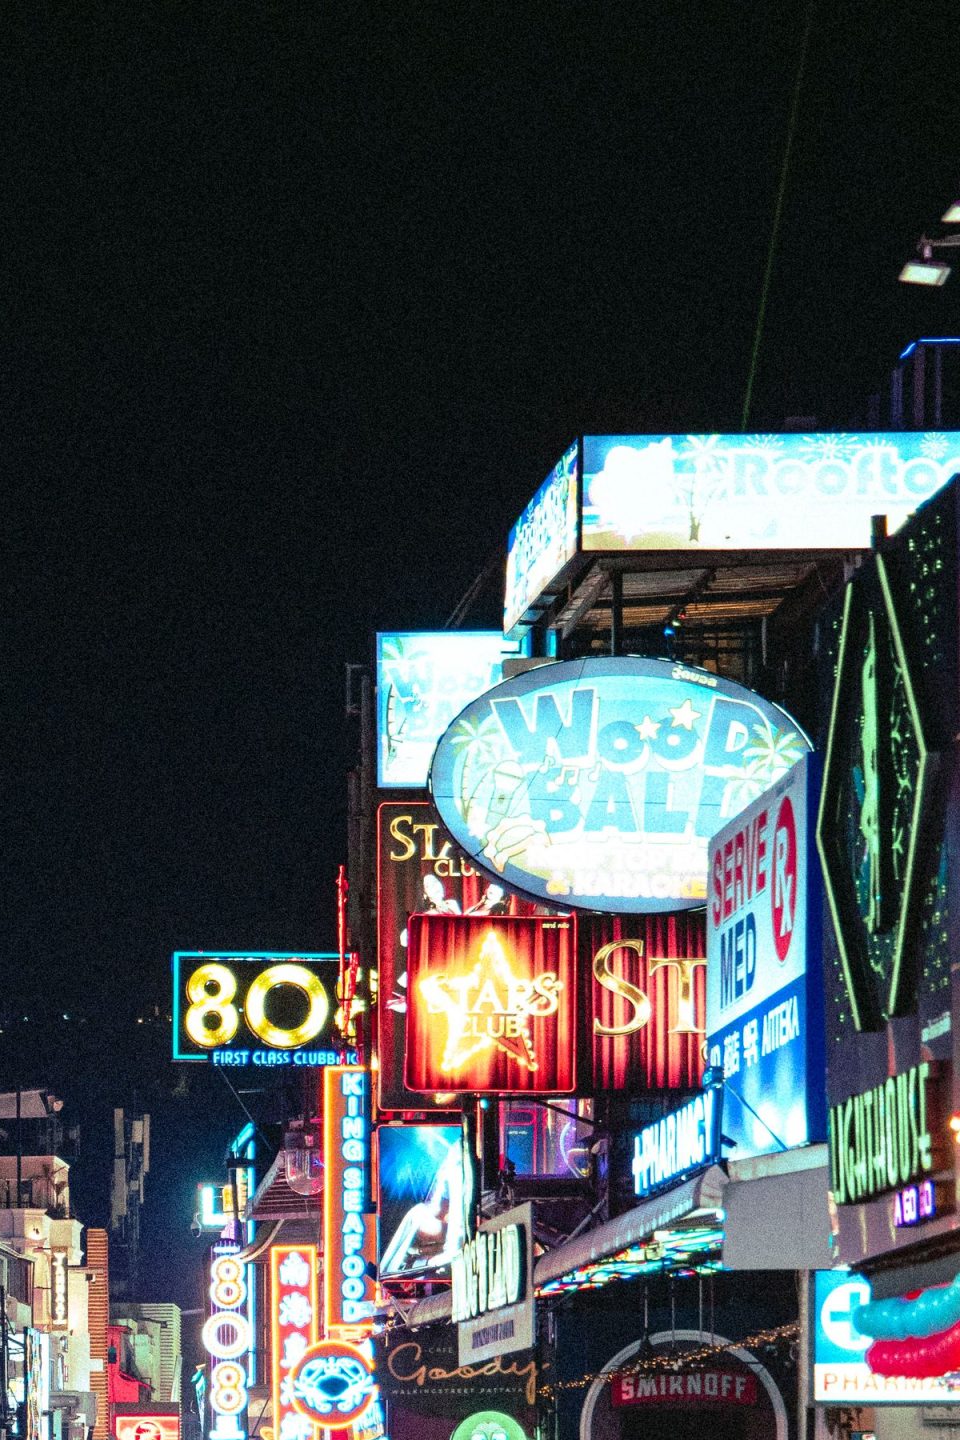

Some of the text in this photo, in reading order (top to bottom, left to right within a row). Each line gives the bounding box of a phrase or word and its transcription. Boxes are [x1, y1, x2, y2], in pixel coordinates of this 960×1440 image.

[734, 451, 960, 497] Roofto
[713, 810, 768, 930] SERVE
[720, 912, 757, 1011] MED
[424, 973, 559, 1017] STARS
[461, 1015, 521, 1038] CLUB
[212, 1051, 249, 1065] FIRST
[252, 1051, 290, 1065] CLASS
[341, 1072, 368, 1324] KING SEAFOOD
[388, 1342, 538, 1405] Goody
[621, 1373, 746, 1400] SMIRNOFF
[823, 1373, 948, 1392] PHARMA
